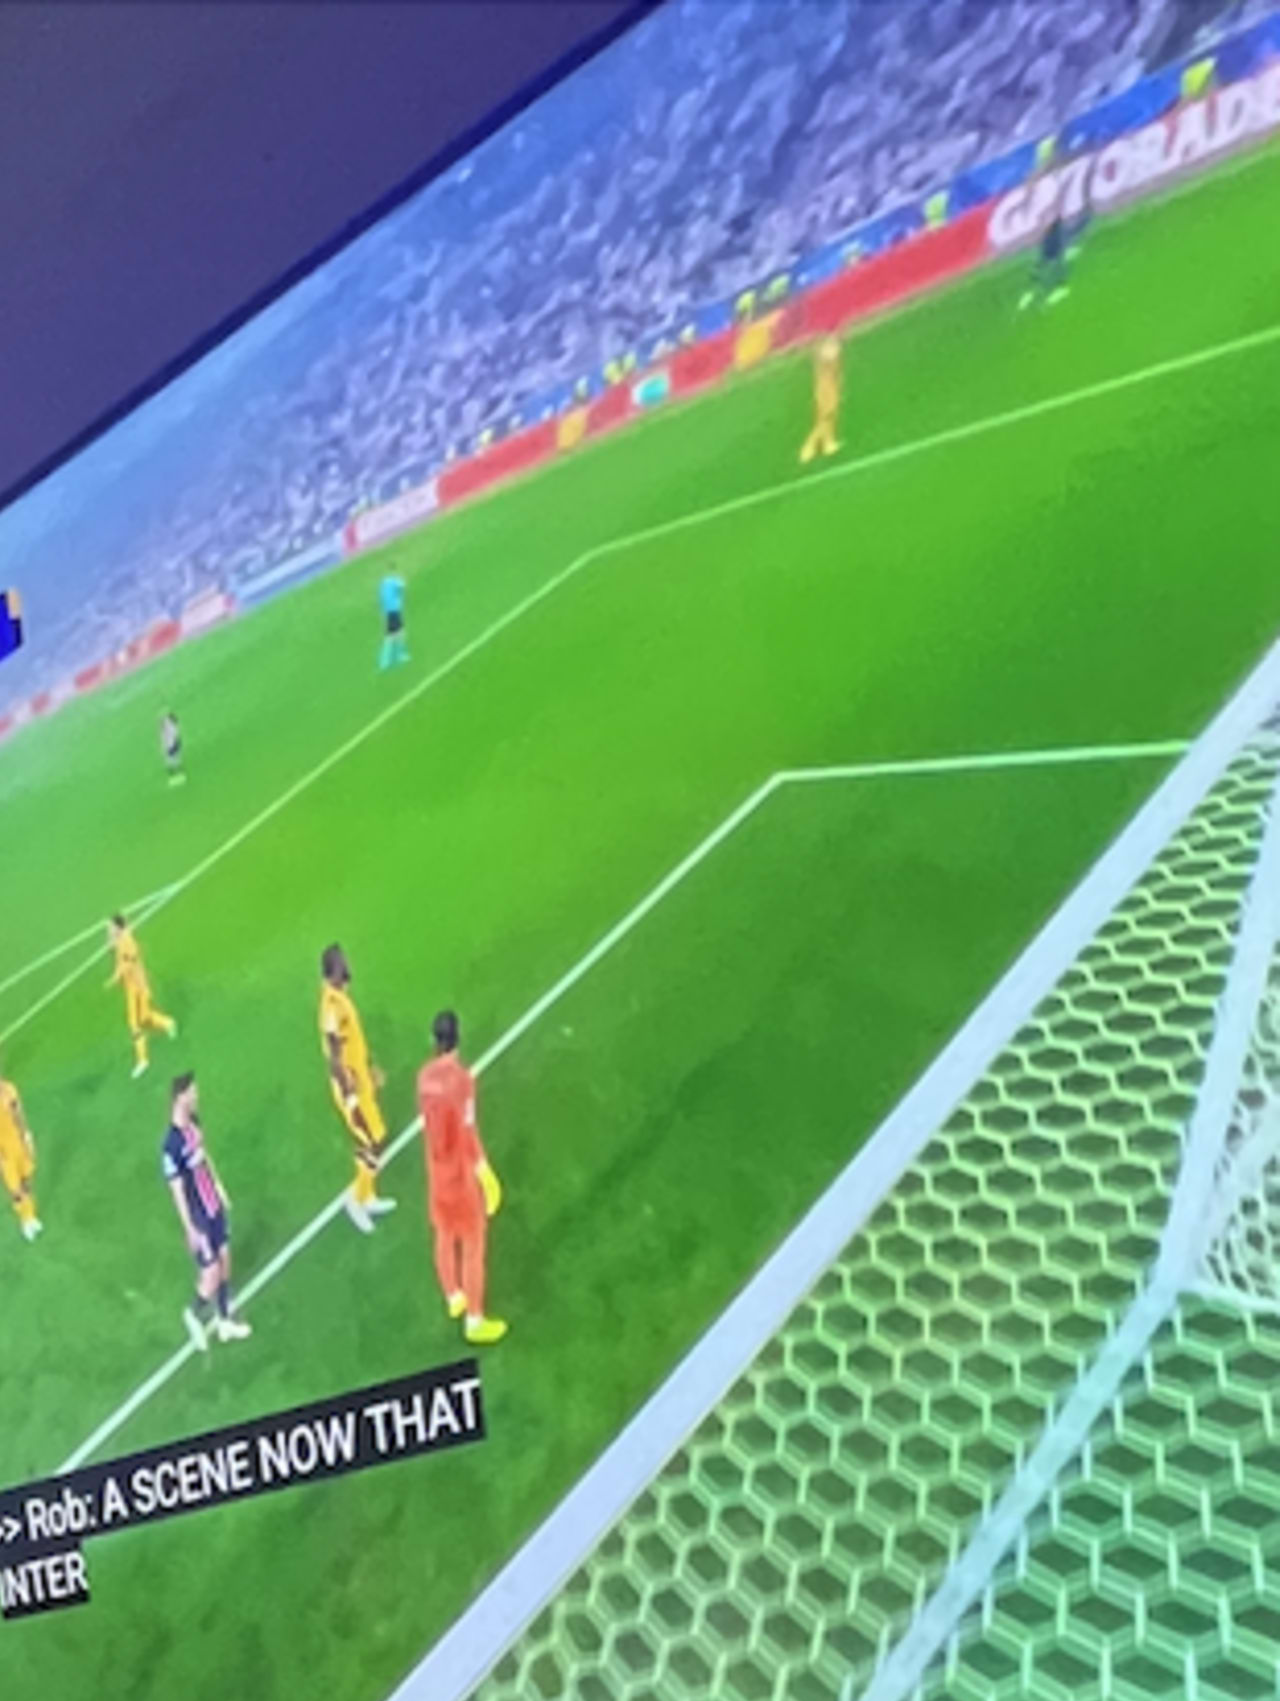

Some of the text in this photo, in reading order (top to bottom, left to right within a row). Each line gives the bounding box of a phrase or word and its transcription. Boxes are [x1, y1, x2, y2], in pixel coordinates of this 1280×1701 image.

[25, 1487, 97, 1542] Rob:
[101, 1476, 130, 1524] A
[131, 1439, 253, 1516] SCENE
[257, 1411, 357, 1484] NOW
[364, 1378, 482, 1454] THAT
